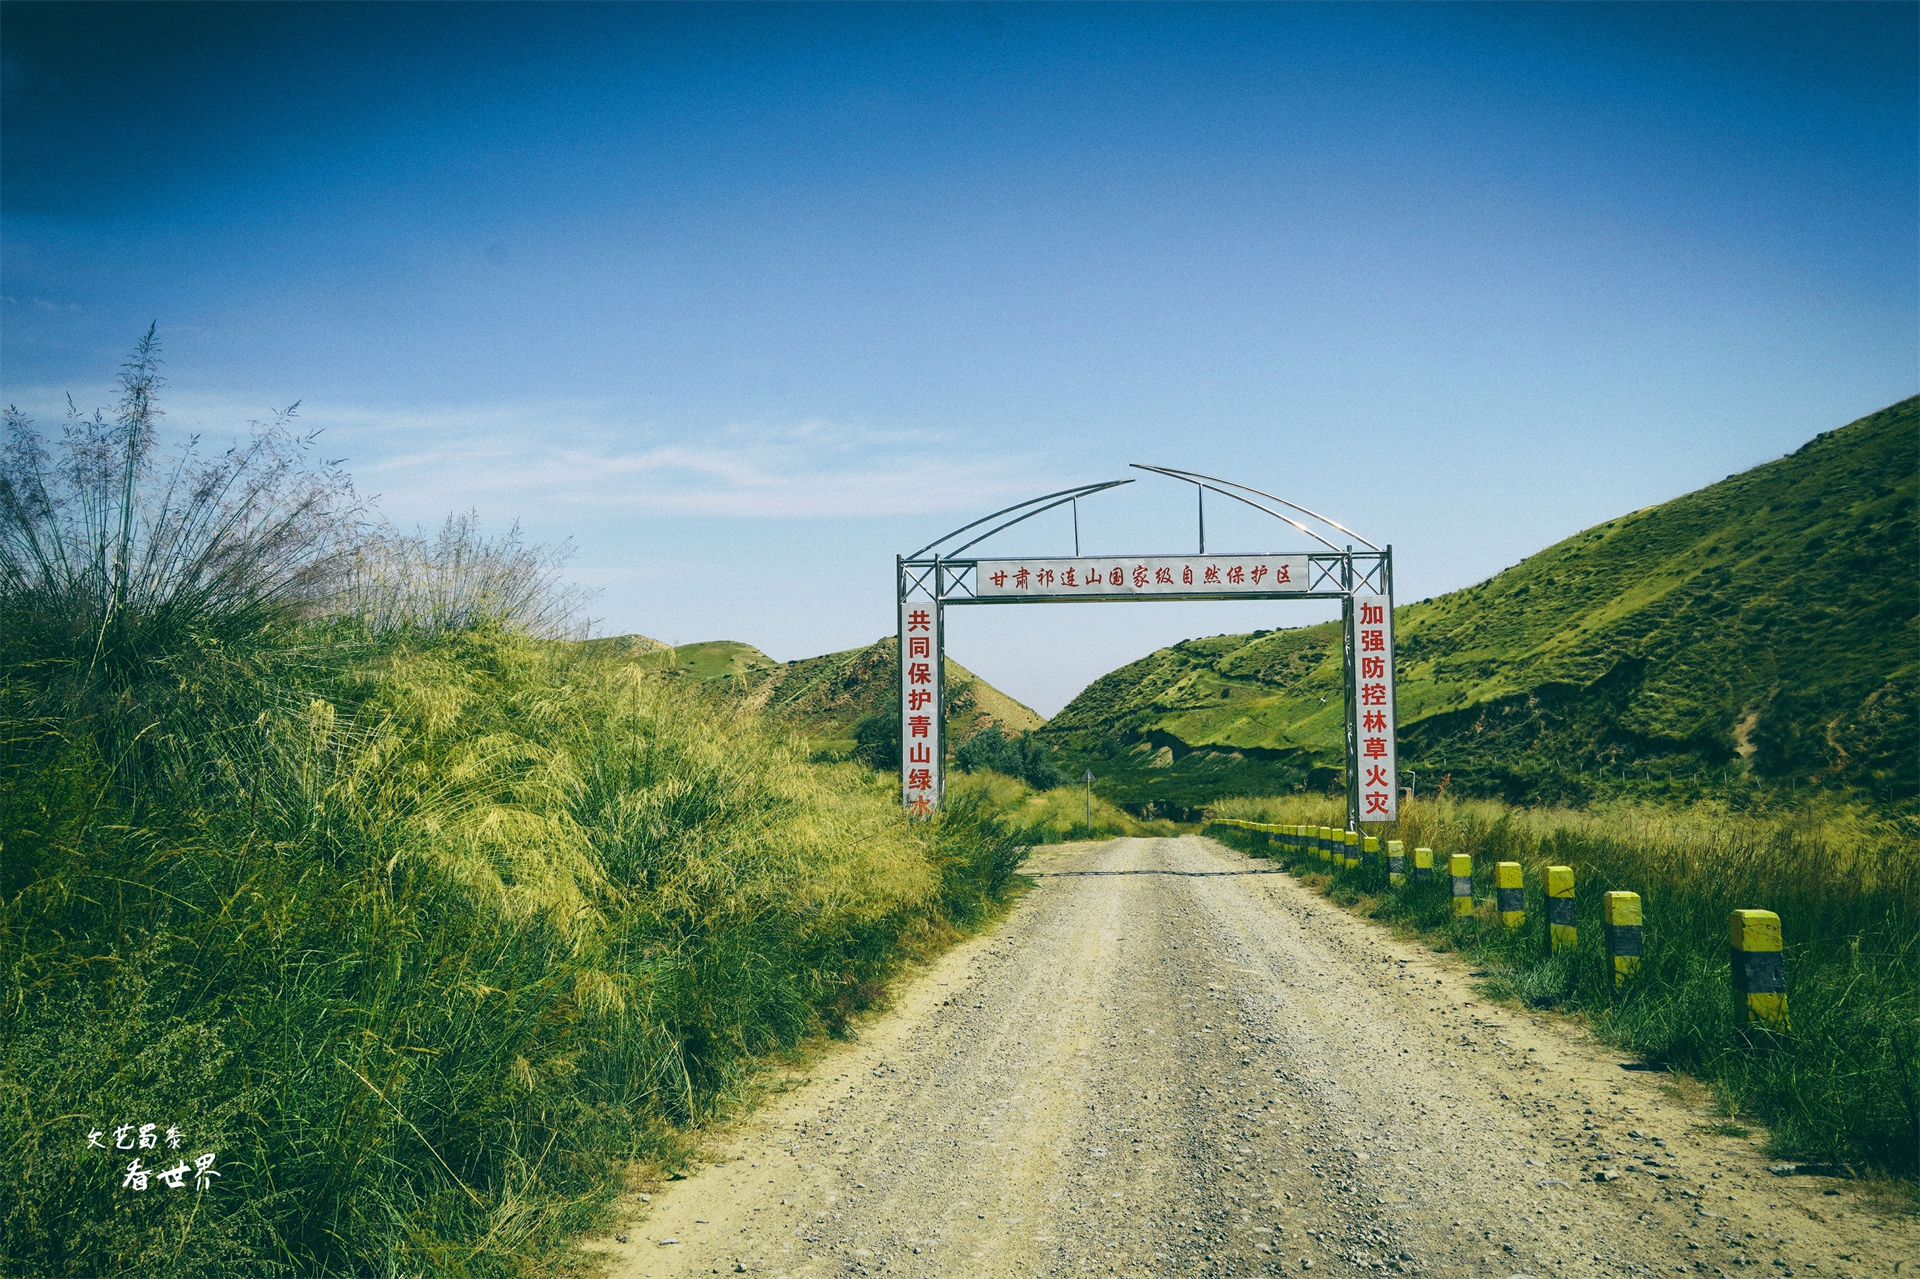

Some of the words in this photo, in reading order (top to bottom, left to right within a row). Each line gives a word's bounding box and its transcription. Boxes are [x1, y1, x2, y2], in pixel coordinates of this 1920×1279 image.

[990, 564, 1292, 590] 甘肃祁连山国家级自然保护区
[907, 609, 932, 818] 共同保护青山绿水
[1360, 602, 1389, 815] 加强防控林草火灾
